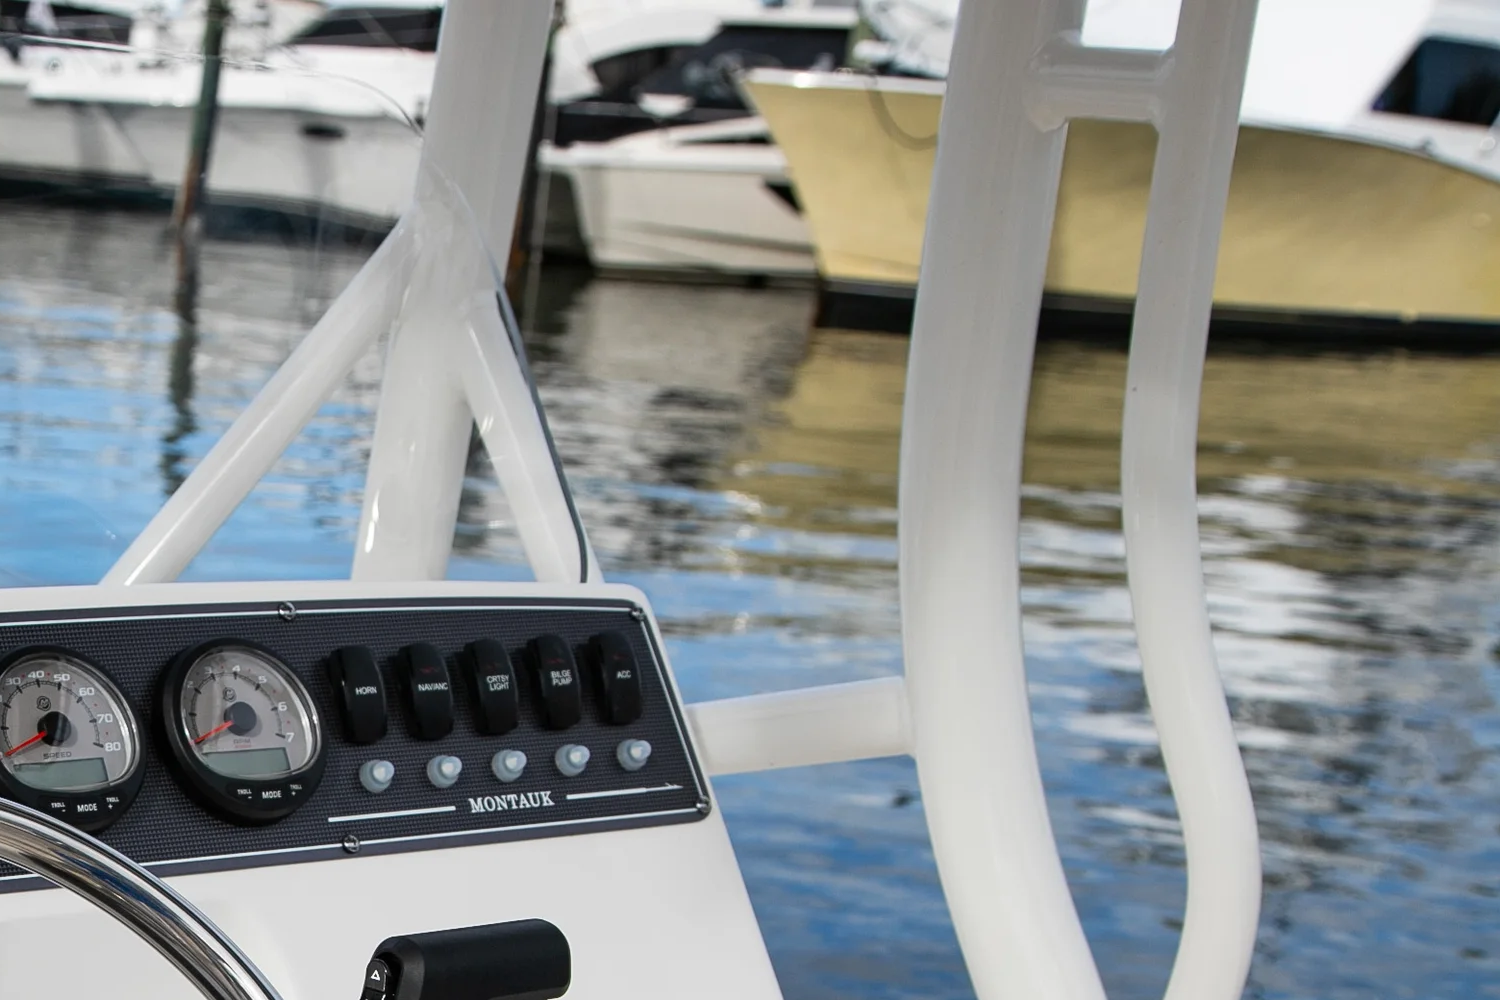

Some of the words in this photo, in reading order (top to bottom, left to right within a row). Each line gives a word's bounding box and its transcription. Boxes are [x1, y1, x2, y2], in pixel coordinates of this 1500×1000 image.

[231, 665, 241, 673] 4
[551, 669, 572, 679] BILGE
[27, 670, 45, 679] 40
[53, 673, 71, 683] 50
[258, 675, 268, 684] 5
[486, 674, 510, 685] CRTSY
[616, 670, 632, 680] ACC
[5, 677, 21, 686] 30
[488, 680, 510, 691] LIGHT
[551, 676, 573, 687] PUMP
[79, 687, 95, 697] 60
[355, 685, 377, 696] HORN
[277, 702, 288, 712] 6
[96, 713, 113, 724] 70
[285, 732, 296, 744] 7
[104, 741, 122, 752] 80
[42, 751, 72, 760] SPEED
[261, 790, 282, 799] MODE
[468, 790, 555, 813] MONTAUK
[77, 803, 98, 813] MODE
